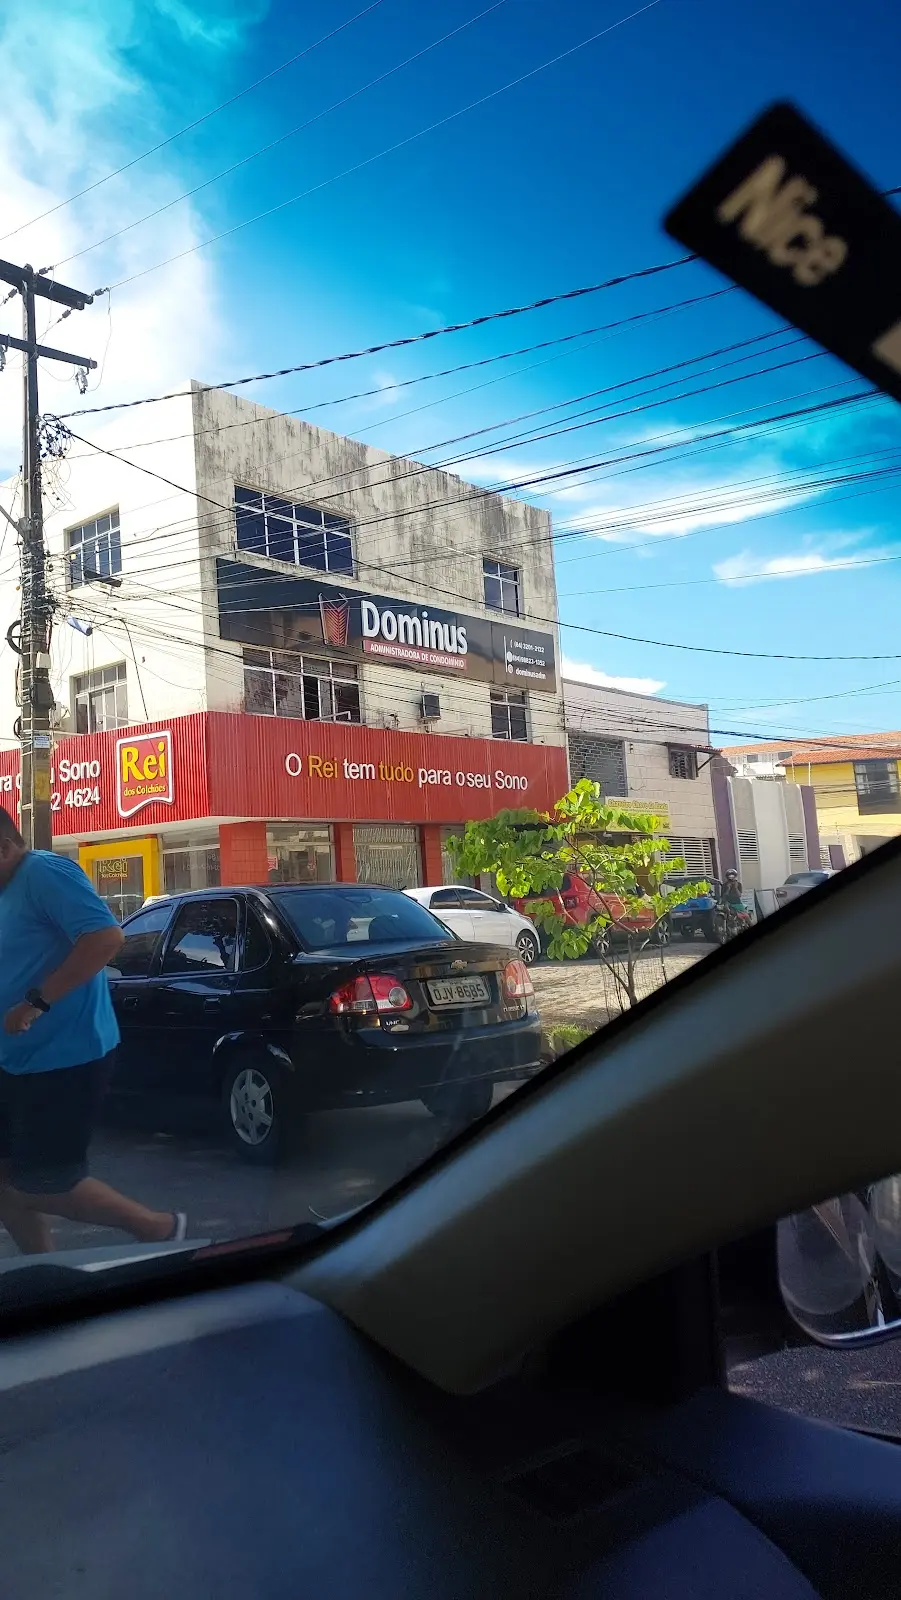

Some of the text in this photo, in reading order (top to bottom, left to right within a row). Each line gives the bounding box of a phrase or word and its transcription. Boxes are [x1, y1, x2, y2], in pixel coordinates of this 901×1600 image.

[714, 153, 849, 287] Nice
[361, 600, 468, 655] Dominus
[370, 643, 420, 660] ADMINISTRADORA
[421, 653, 429, 662] DE
[59, 759, 100, 783] Sono
[121, 741, 166, 783] Rei
[285, 752, 528, 791] O Rei tem tudo para o seu Sono
[65, 787, 100, 809] 4624
[123, 783, 166, 797] dos Colchões
[99, 857, 128, 873] Rei
